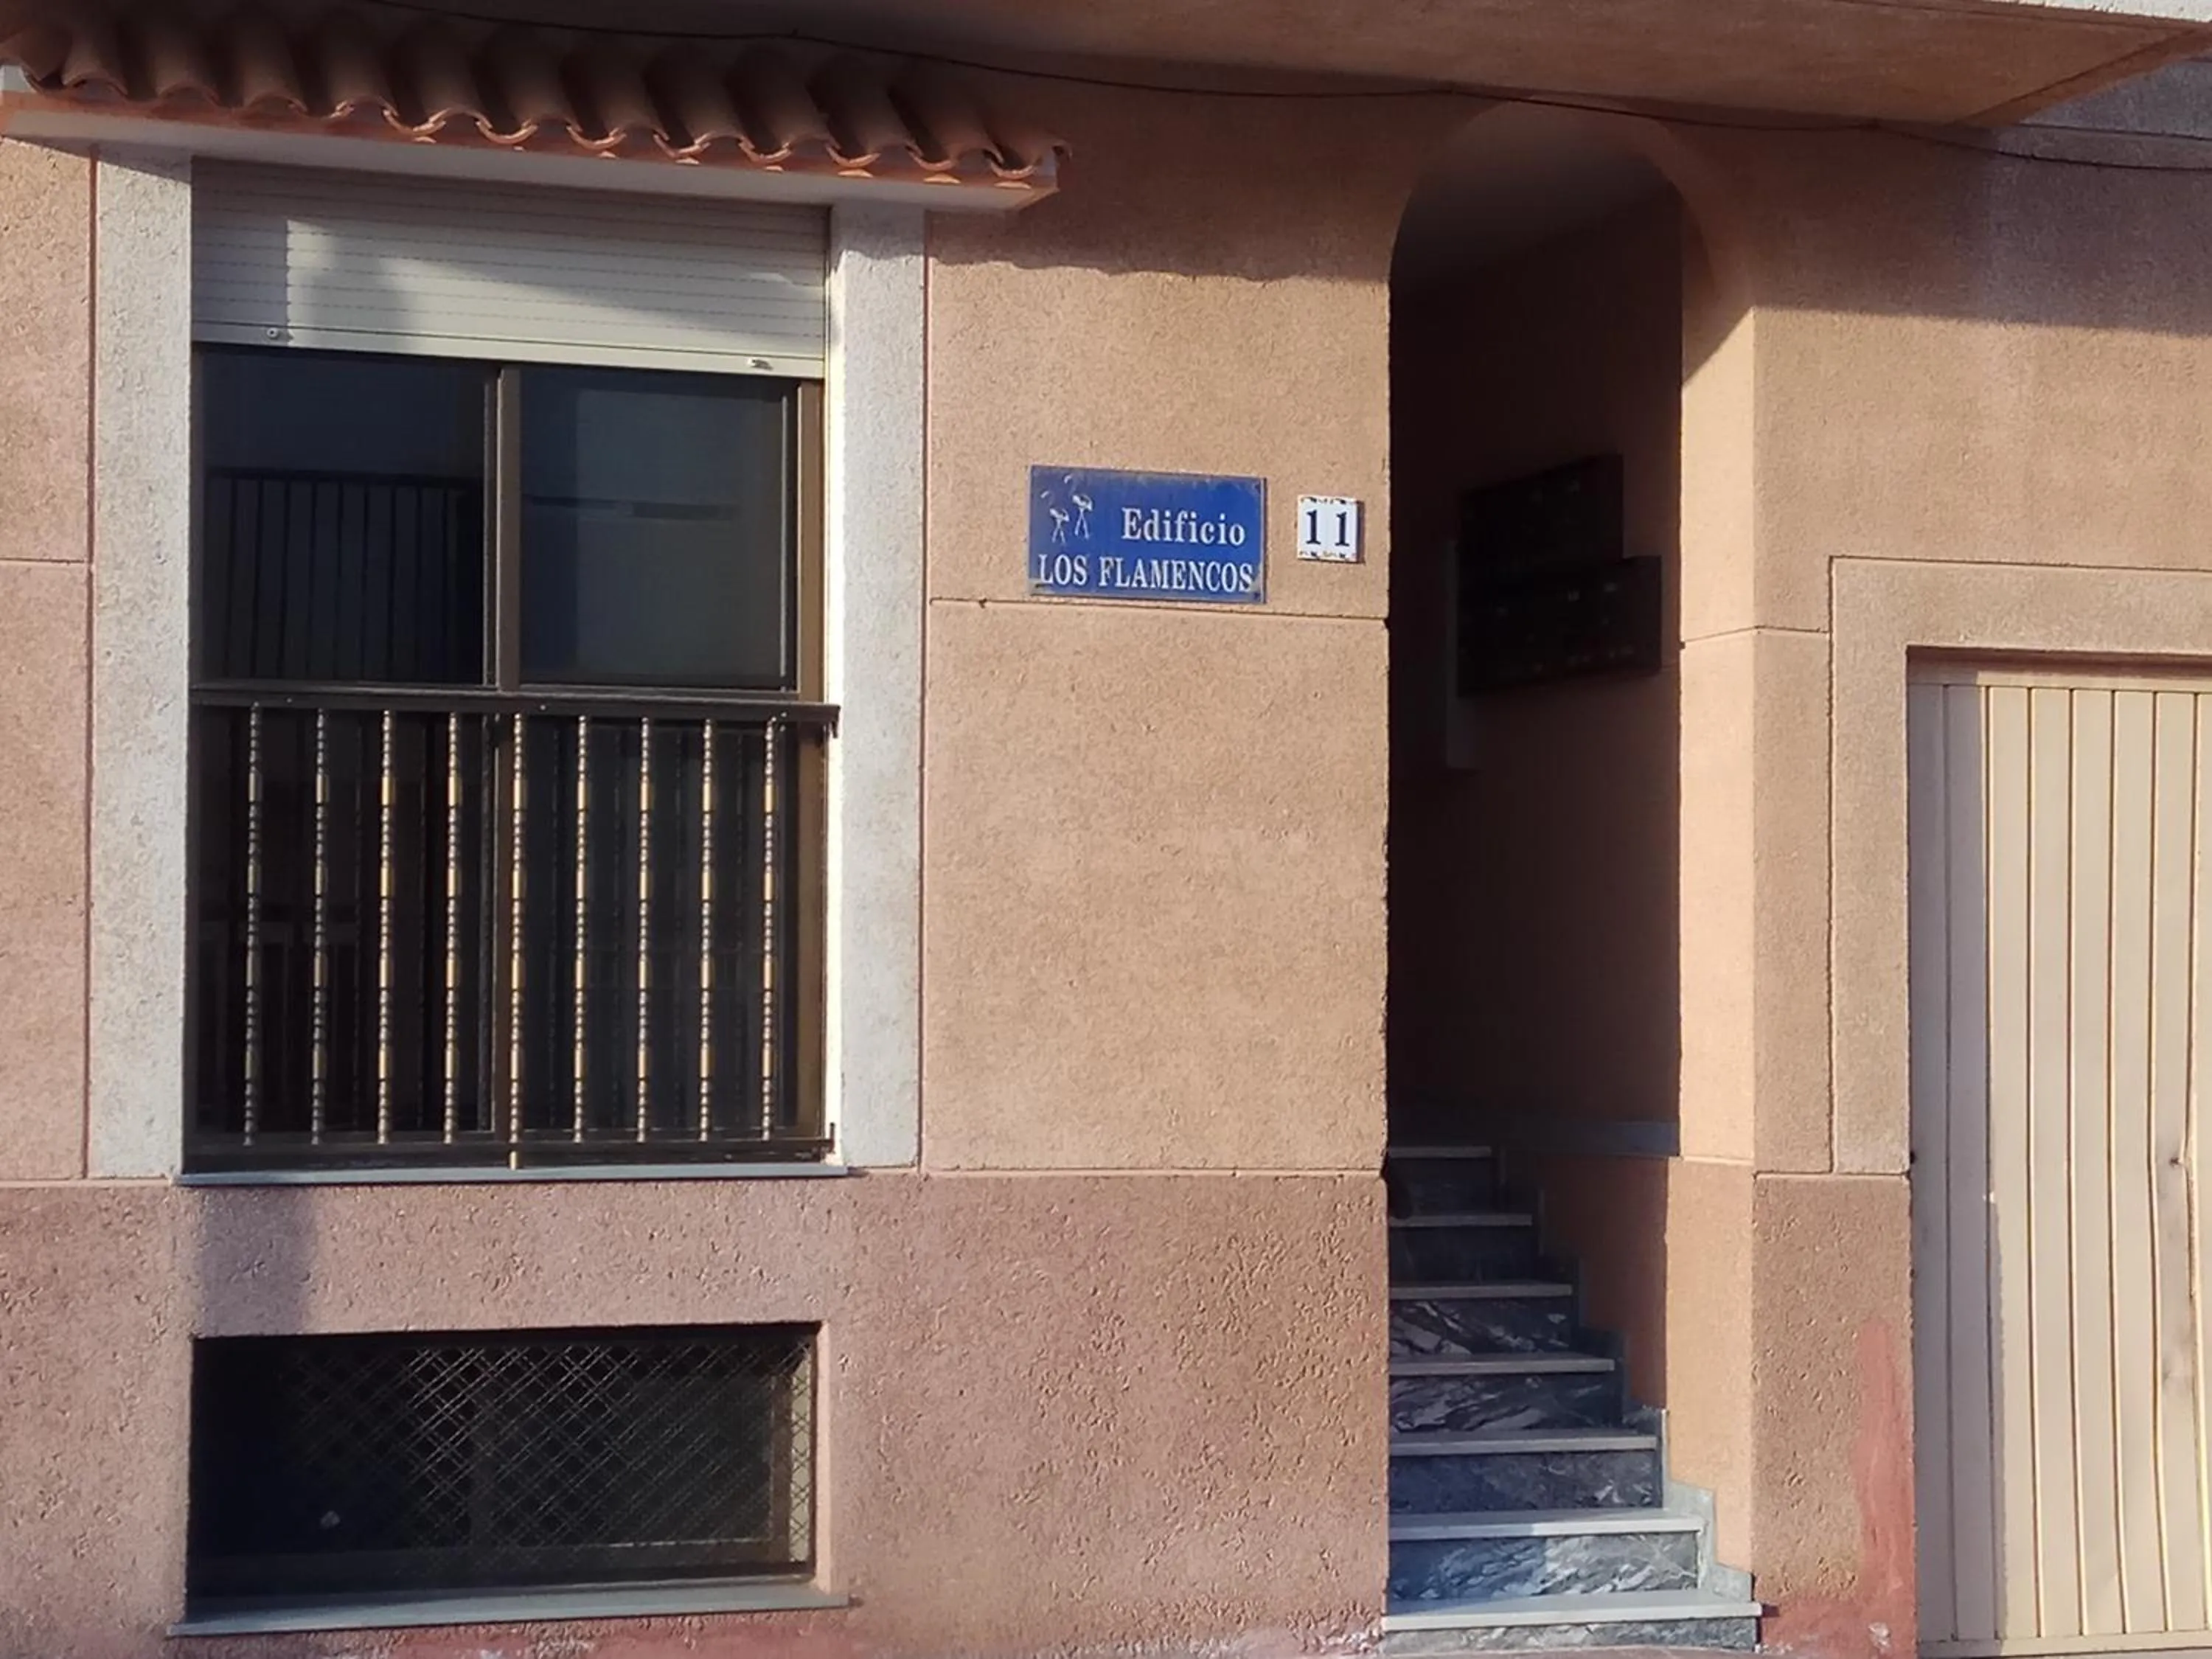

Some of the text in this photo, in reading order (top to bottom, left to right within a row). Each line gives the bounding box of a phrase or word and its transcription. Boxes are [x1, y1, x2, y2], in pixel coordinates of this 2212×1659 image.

[1121, 507, 1245, 546] Edificio
[1306, 509, 1350, 546] 11
[1038, 553, 1253, 592] LOS FLAMENCOS
